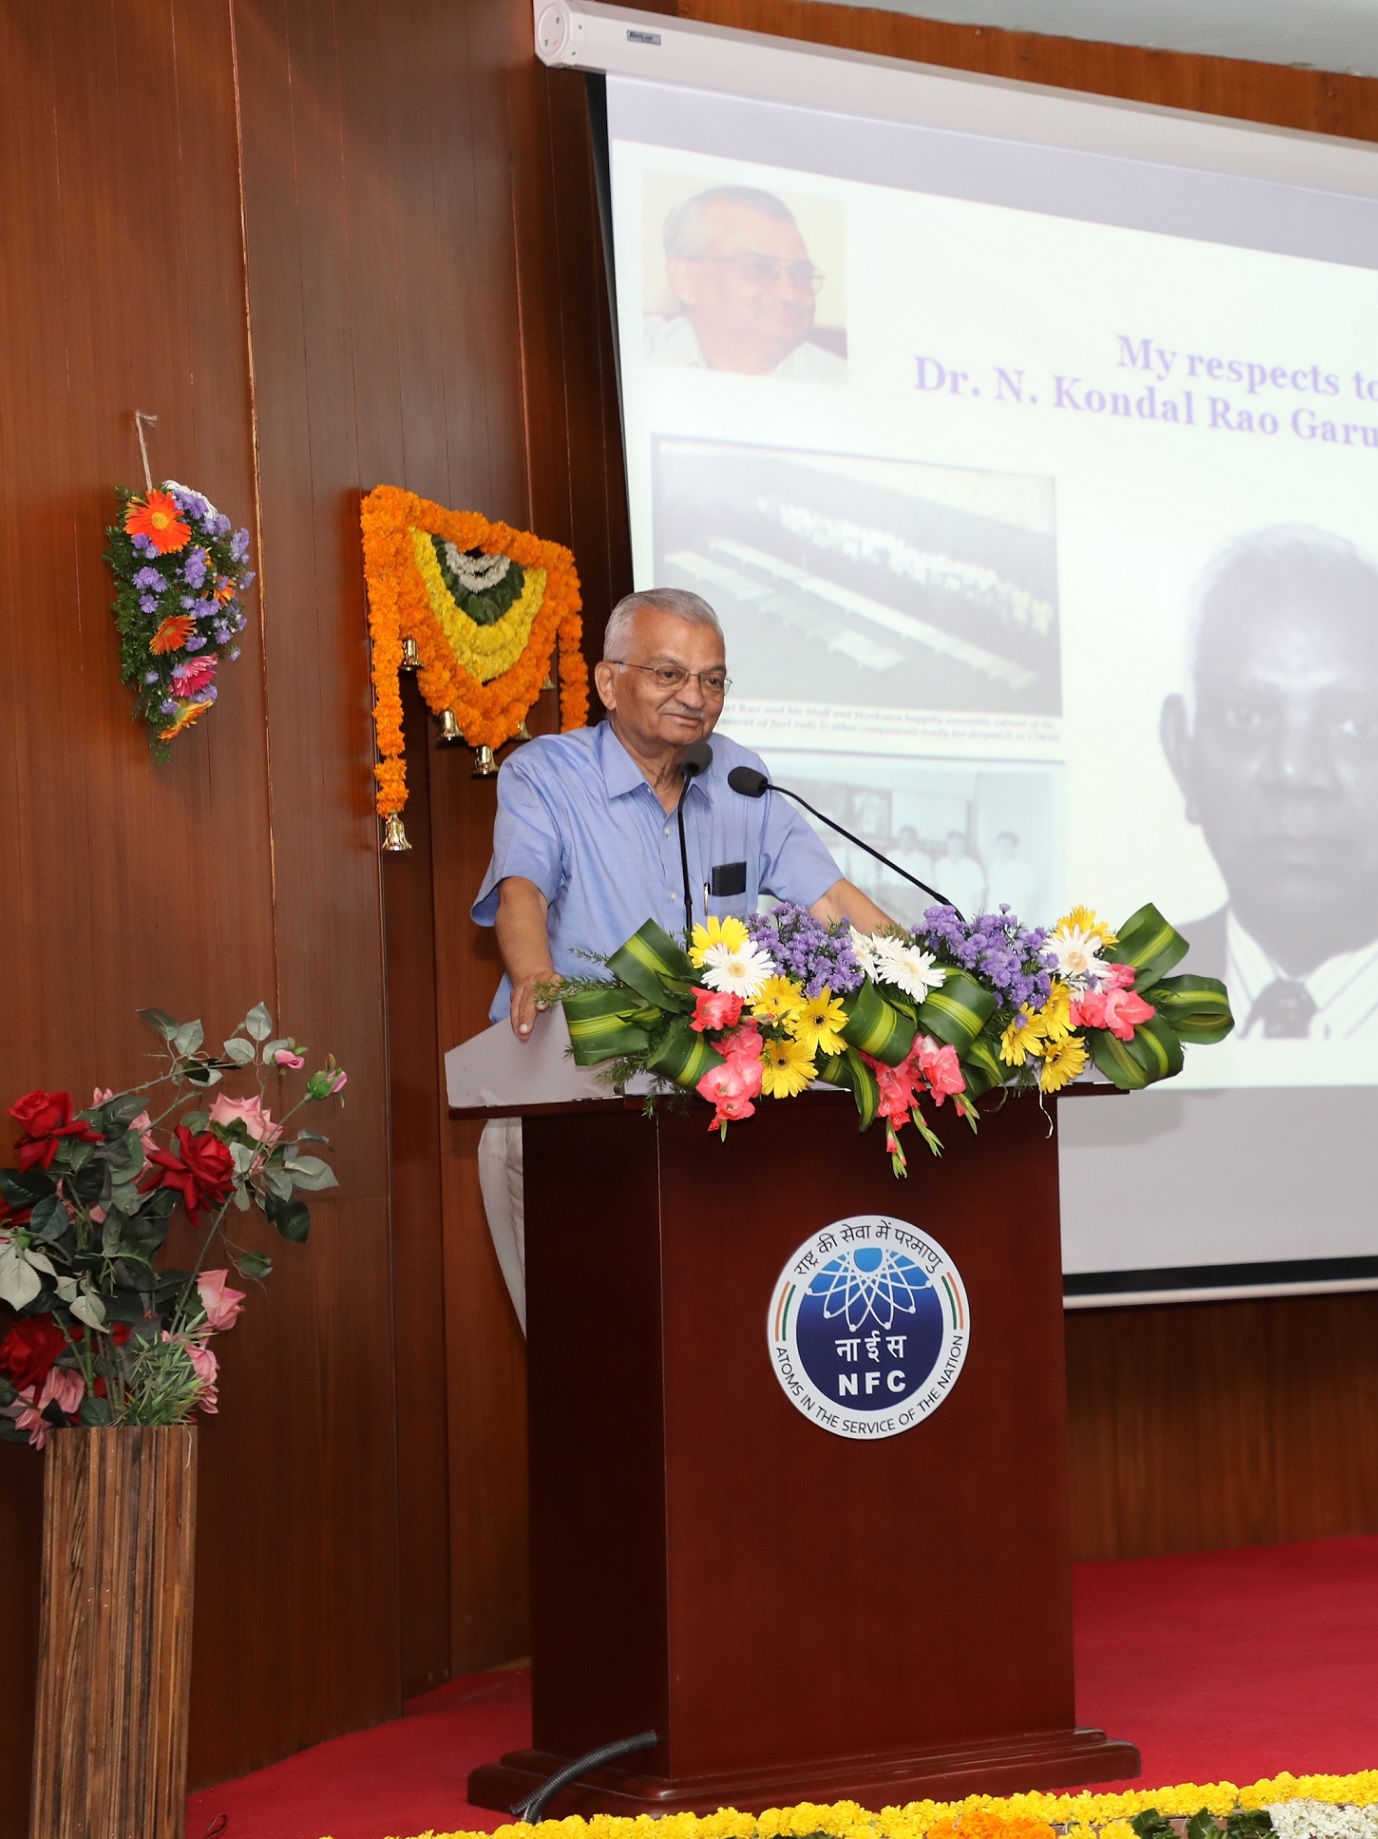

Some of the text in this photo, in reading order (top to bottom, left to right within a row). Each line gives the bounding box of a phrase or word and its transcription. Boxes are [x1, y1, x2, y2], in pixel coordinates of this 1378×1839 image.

[914, 355, 981, 397] Dr.
[994, 366, 1039, 405] N.
[1052, 373, 1196, 426] Kondal
[1208, 396, 1280, 436] Rao
[1116, 334, 1178, 381] My
[1186, 353, 1341, 397] respects
[816, 1232, 838, 1254] की
[840, 1223, 871, 1244] सेवा
[875, 1219, 892, 1241] में
[894, 1228, 944, 1275] परमाणु
[776, 1334, 964, 1435] ATOMS IN THE SERVICE OF THE NATION
[838, 1370, 907, 1397] NFC
